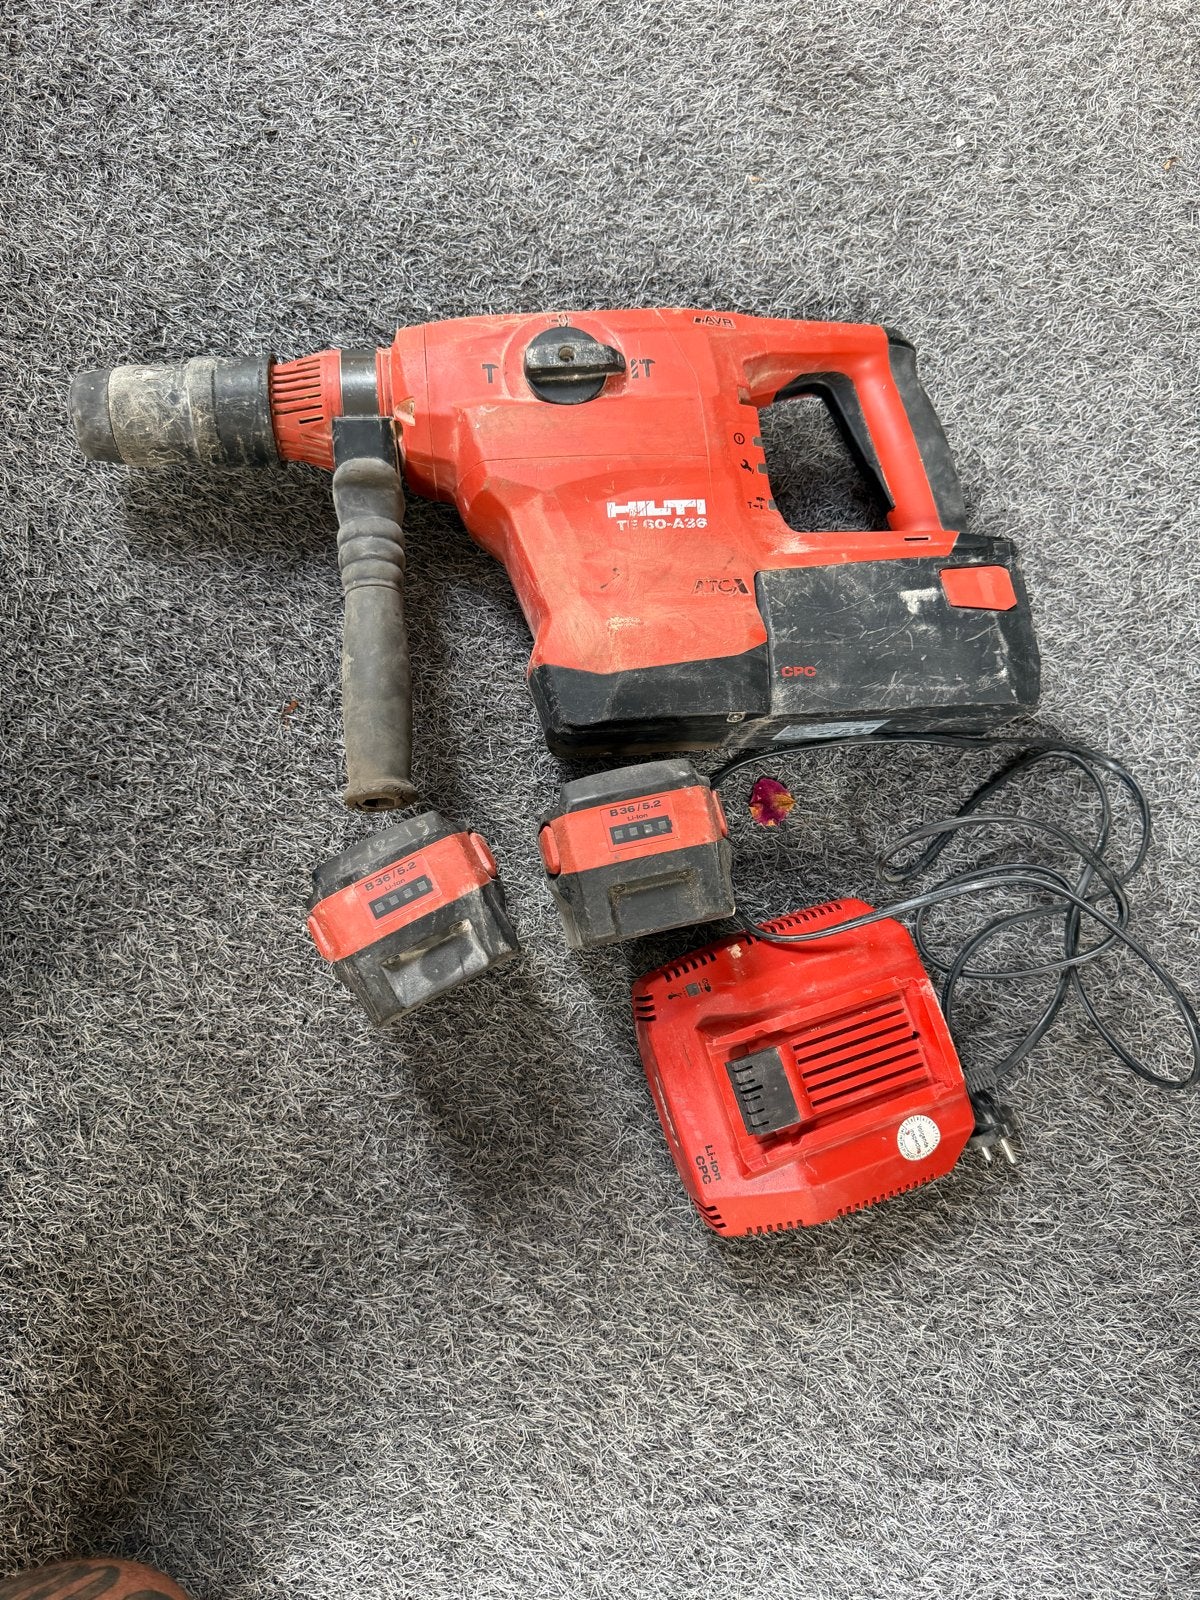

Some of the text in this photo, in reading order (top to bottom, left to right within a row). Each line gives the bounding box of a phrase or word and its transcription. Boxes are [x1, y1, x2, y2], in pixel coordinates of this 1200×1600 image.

[704, 315, 734, 328] AVR
[606, 499, 707, 518] HILTI
[642, 517, 708, 530] 60-A36
[781, 666, 817, 678] CPC
[627, 813, 649, 822] Li-Ion
[704, 1144, 721, 1181] Li-Ion
[695, 1155, 711, 1185] CPC
